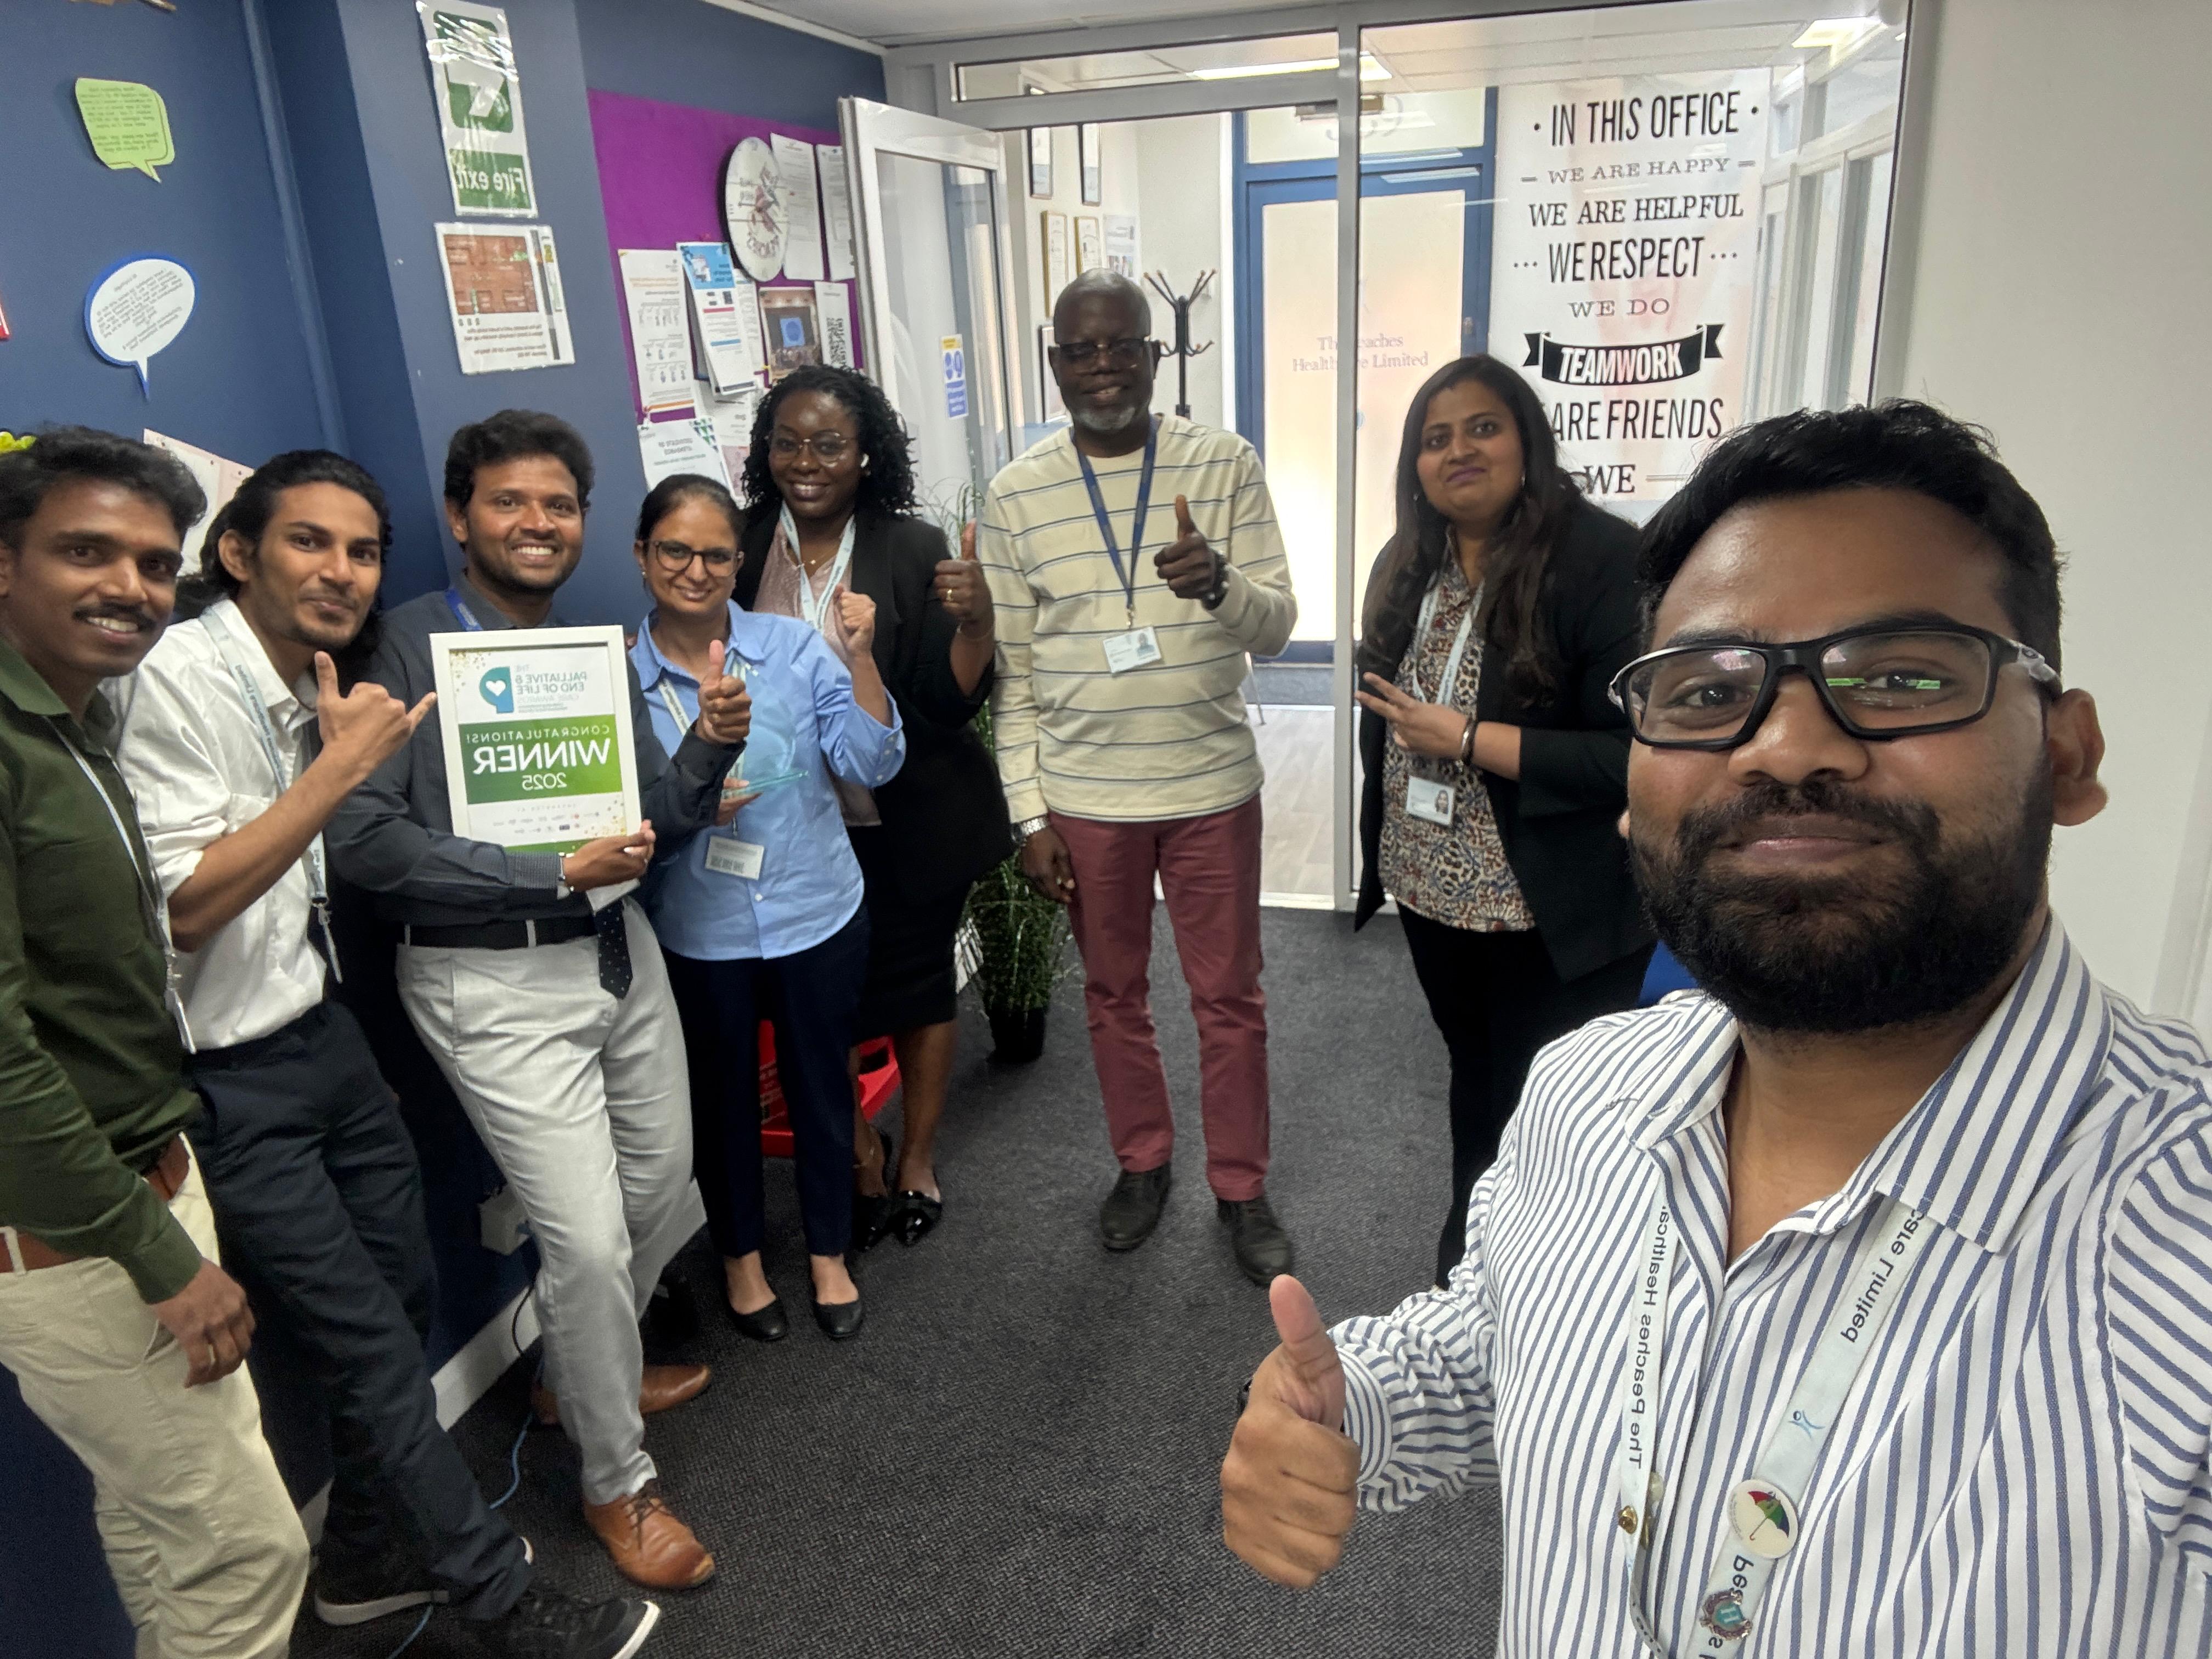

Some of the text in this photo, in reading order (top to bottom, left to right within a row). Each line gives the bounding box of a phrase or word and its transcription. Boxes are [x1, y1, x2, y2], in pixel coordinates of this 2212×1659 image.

[1551, 91, 1740, 146] IN THIS OFFICE
[1547, 157, 1731, 184] WE ARE HAPPY
[1529, 193, 1744, 227] WE ARE HELPFUL
[1568, 298, 1671, 318] WE DO
[1373, 350, 1429, 368] Limited
[1559, 342, 1683, 383] TEAMWORK
[1553, 397, 1724, 442] ARE FRIENDS
[1583, 464, 1636, 494] WE
